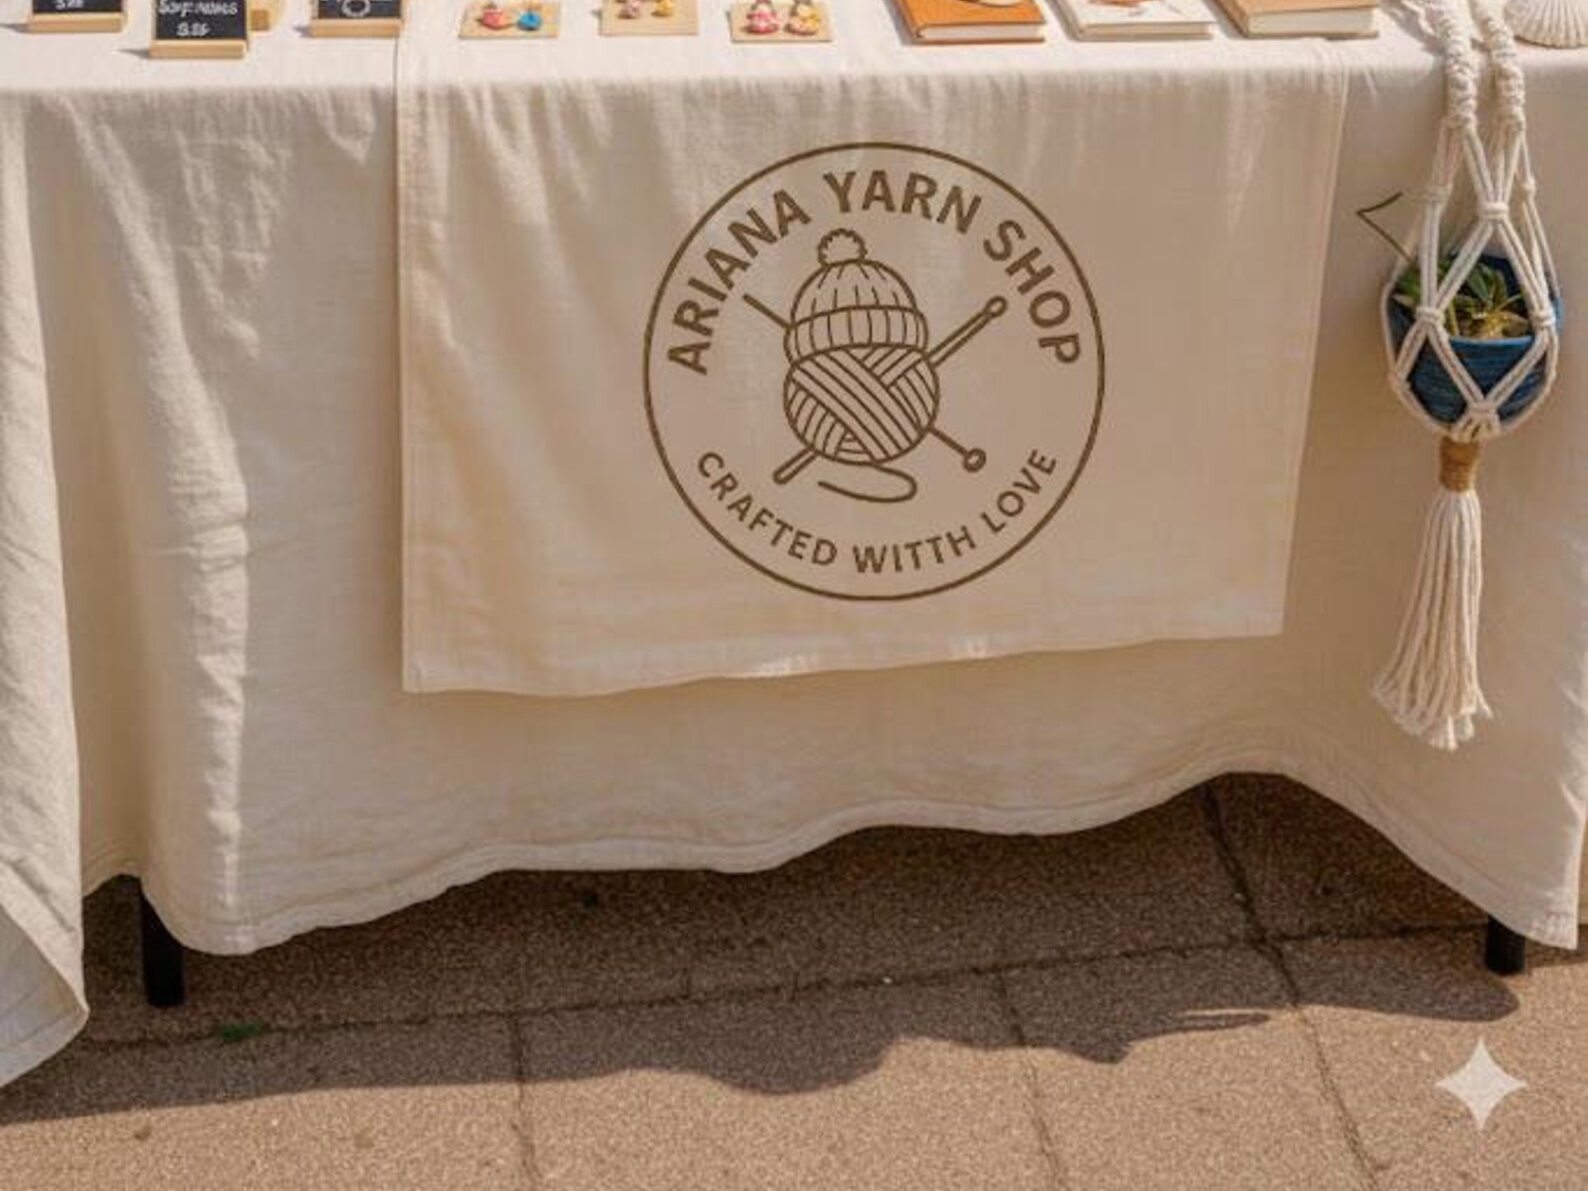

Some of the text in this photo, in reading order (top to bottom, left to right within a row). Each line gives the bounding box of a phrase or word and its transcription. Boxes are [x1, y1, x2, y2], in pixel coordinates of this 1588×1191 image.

[667, 169, 1082, 376] ARIANA YARN SHOP
[697, 449, 1057, 574] CRAFTED WITTH LOVE
